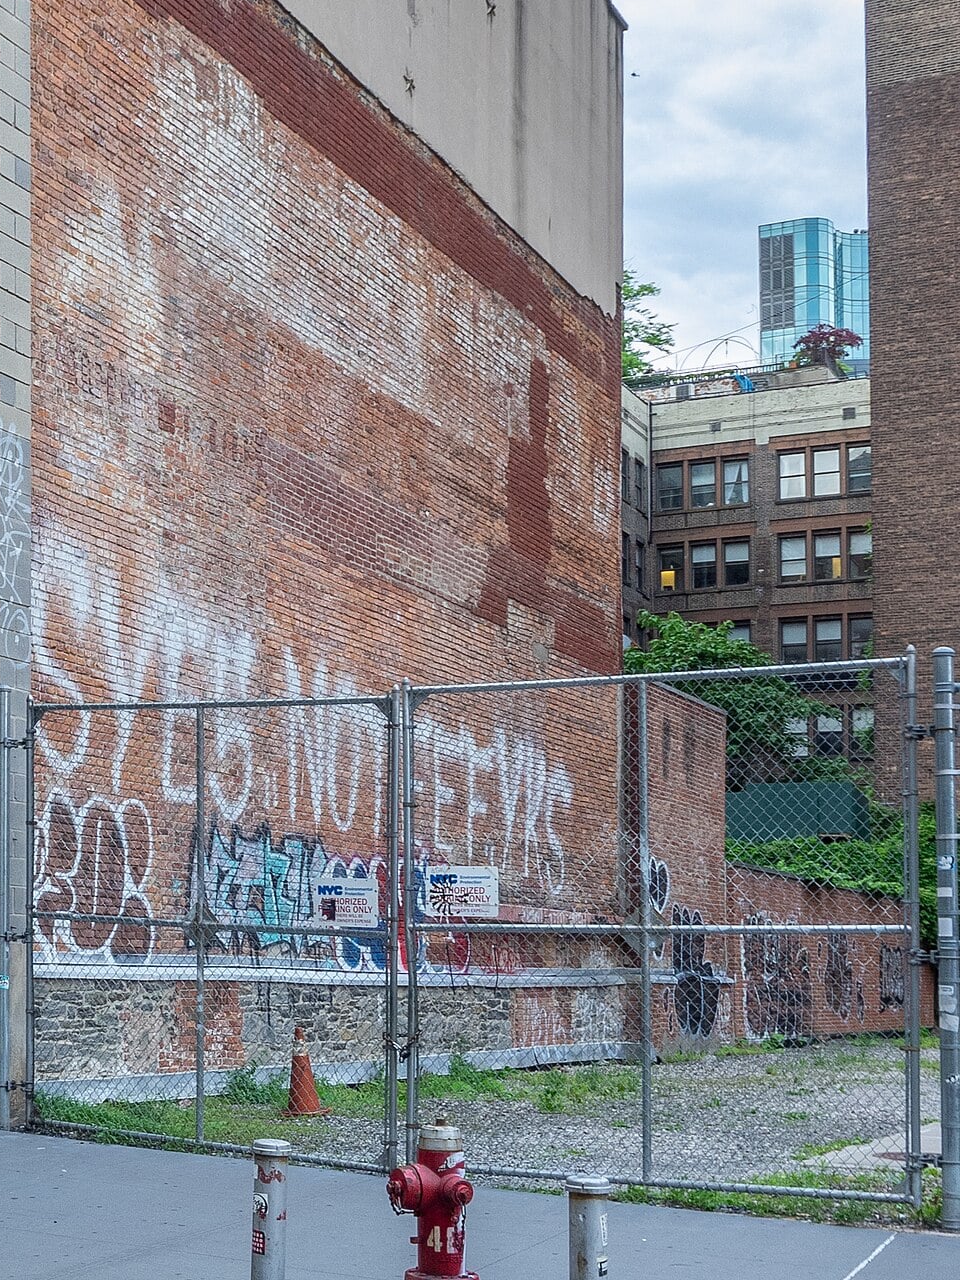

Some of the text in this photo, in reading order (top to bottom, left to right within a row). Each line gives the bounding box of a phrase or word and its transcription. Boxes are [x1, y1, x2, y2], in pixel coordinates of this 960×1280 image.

[430, 874, 458, 884] NYC
[318, 885, 343, 895] NYC
[433, 886, 486, 895] THORIZED
[321, 897, 368, 906] AHORIZED
[469, 895, 491, 903] ONLY
[318, 905, 351, 913] PKING
